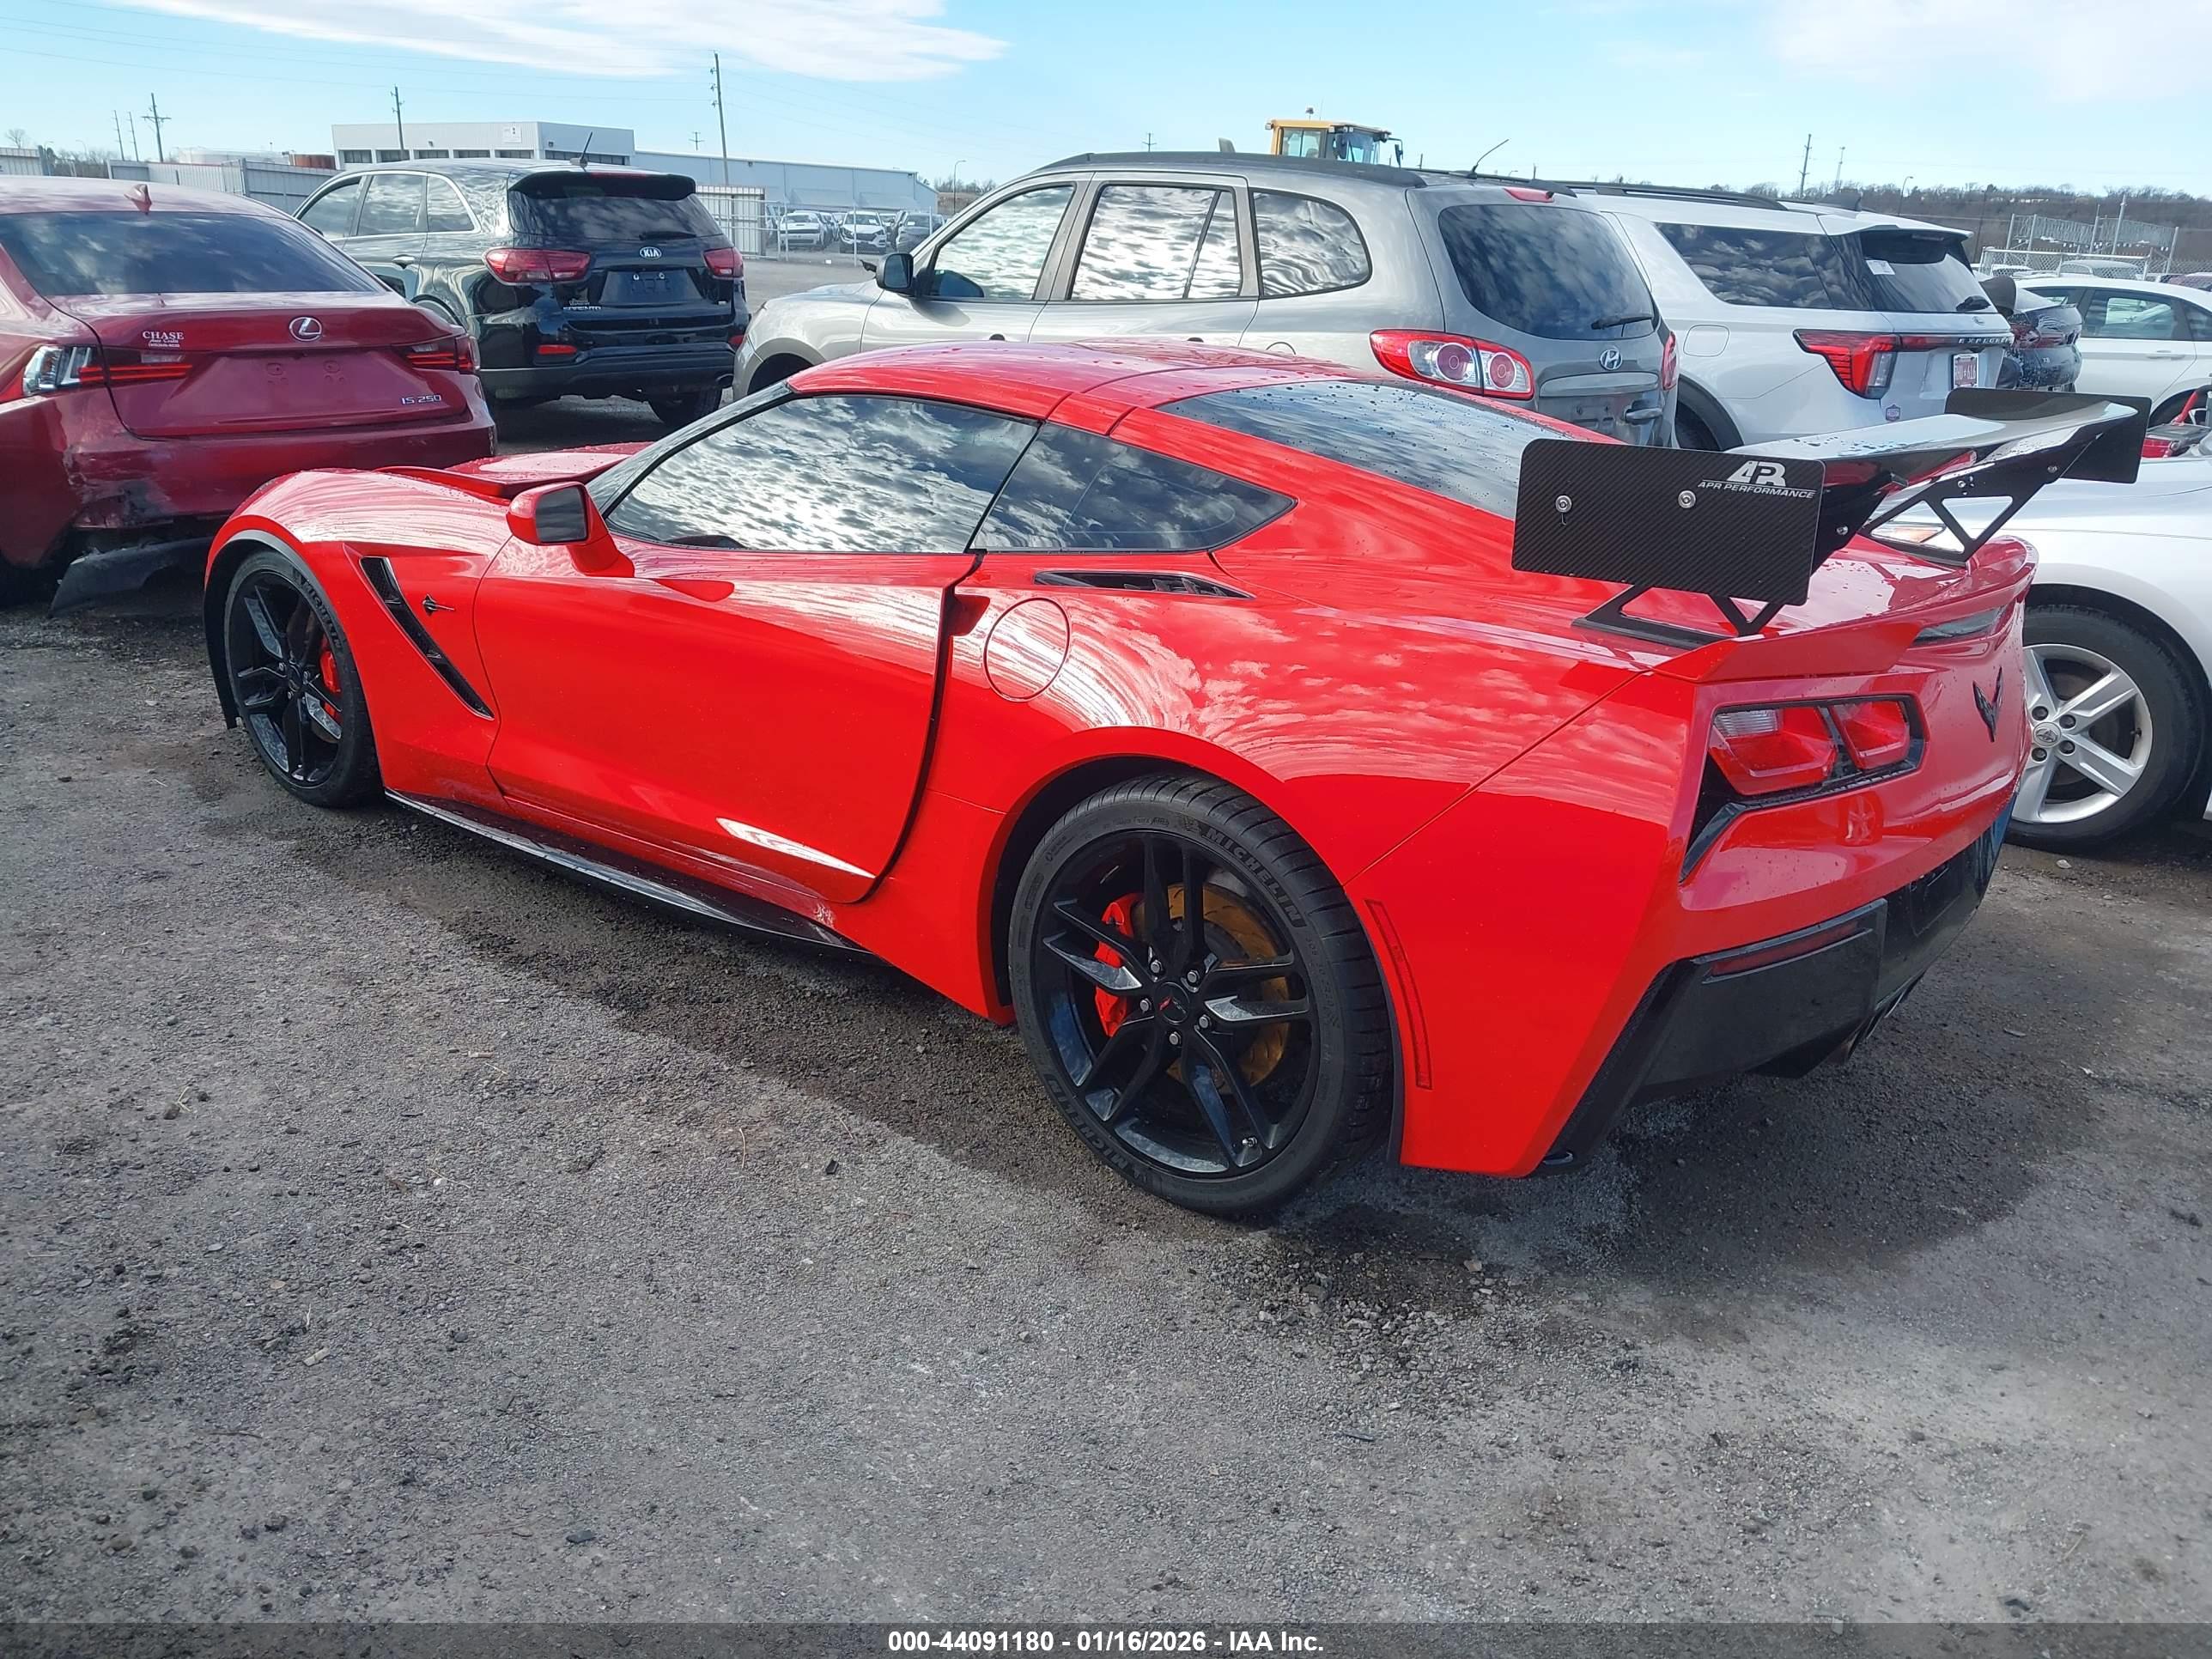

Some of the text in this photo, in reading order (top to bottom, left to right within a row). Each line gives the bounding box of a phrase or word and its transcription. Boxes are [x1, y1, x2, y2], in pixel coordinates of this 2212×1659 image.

[143, 331, 185, 340] CHASE
[417, 394, 442, 404] 250
[1697, 481, 1817, 499] APR PERFORMANCE
[1205, 827, 1301, 922] MICHELIN
[1047, 1079, 1130, 1170] MICHELIN
